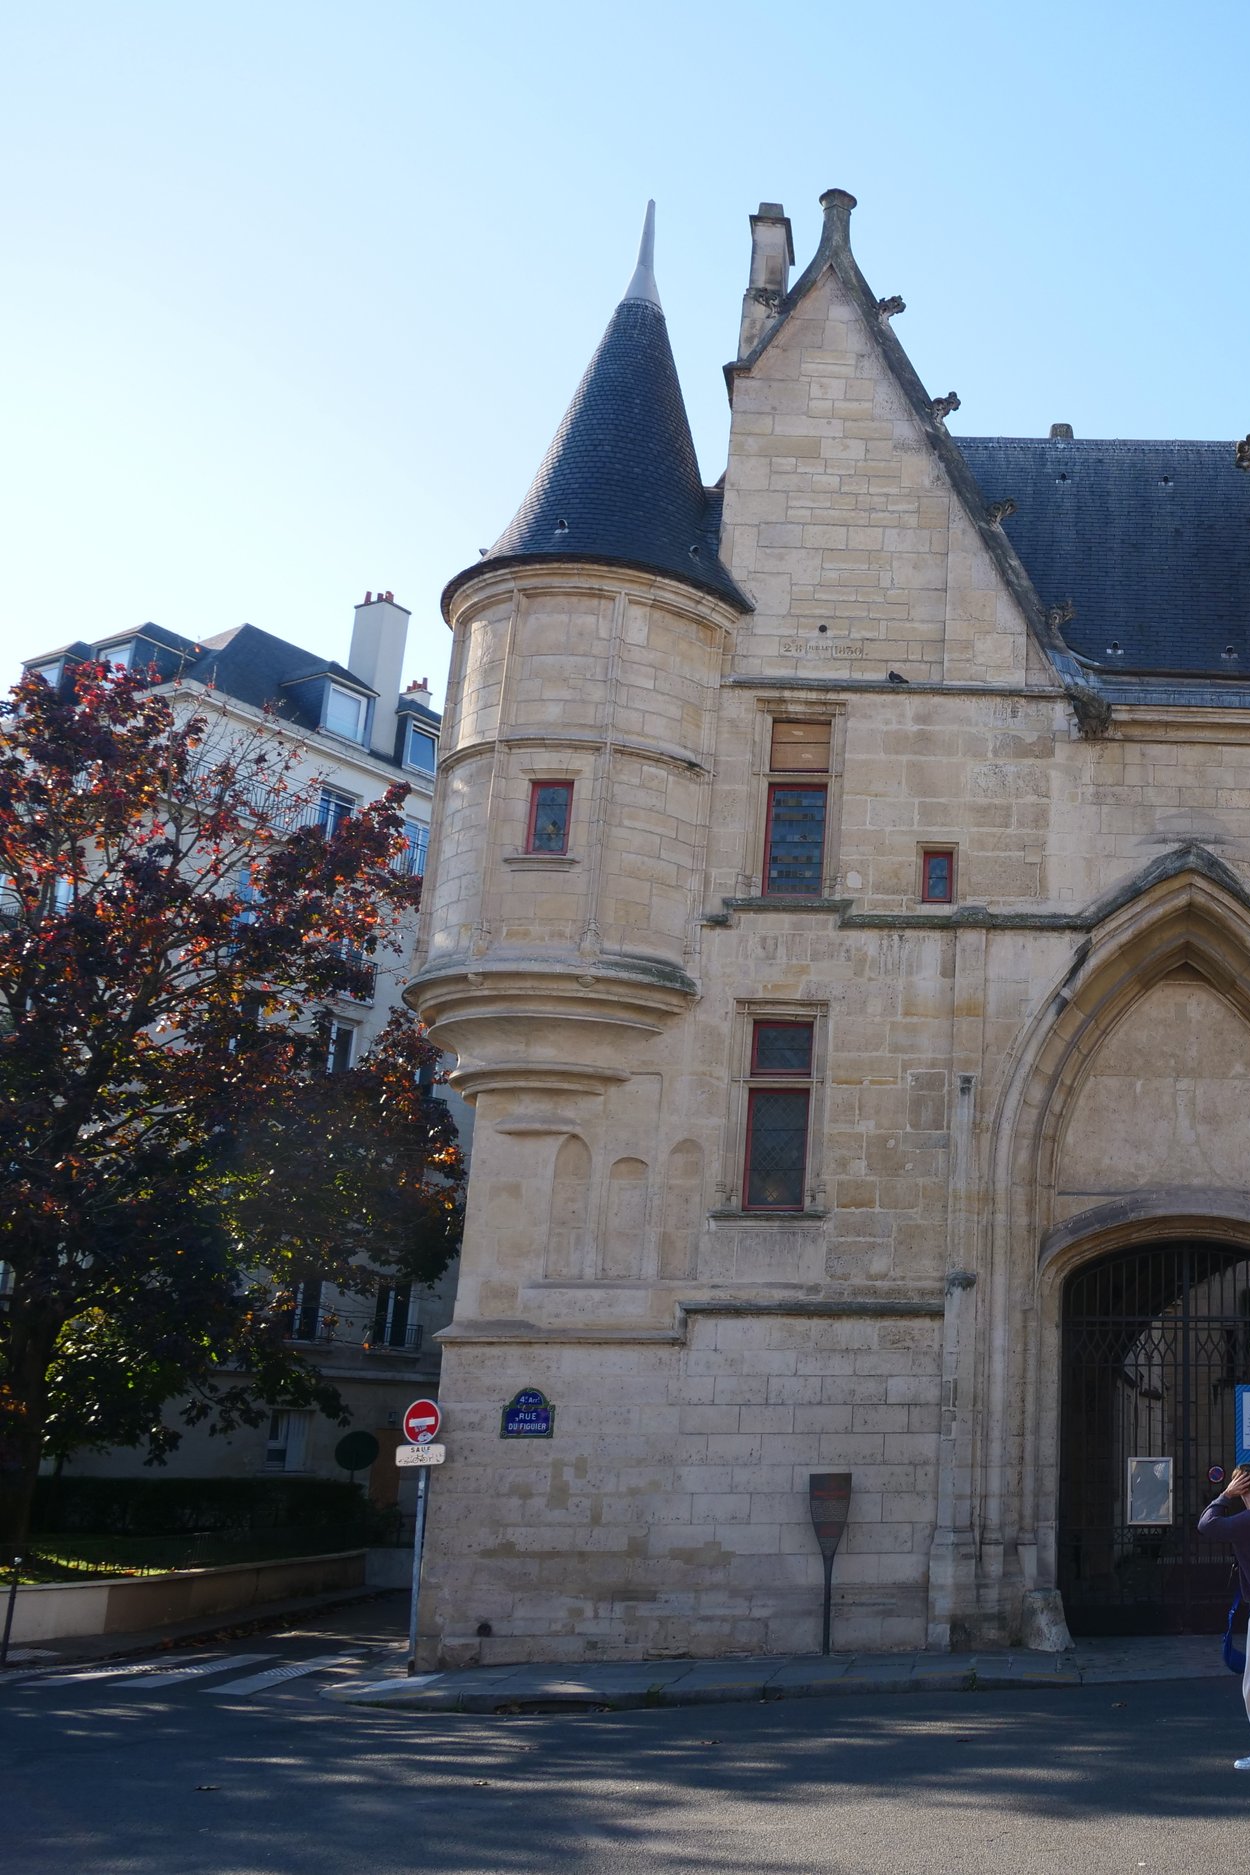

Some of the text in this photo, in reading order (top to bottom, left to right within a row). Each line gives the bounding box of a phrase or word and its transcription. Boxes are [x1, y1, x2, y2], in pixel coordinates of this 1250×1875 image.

[518, 1412, 537, 1420] RUE
[508, 1422, 547, 1430] DU FIGUIER
